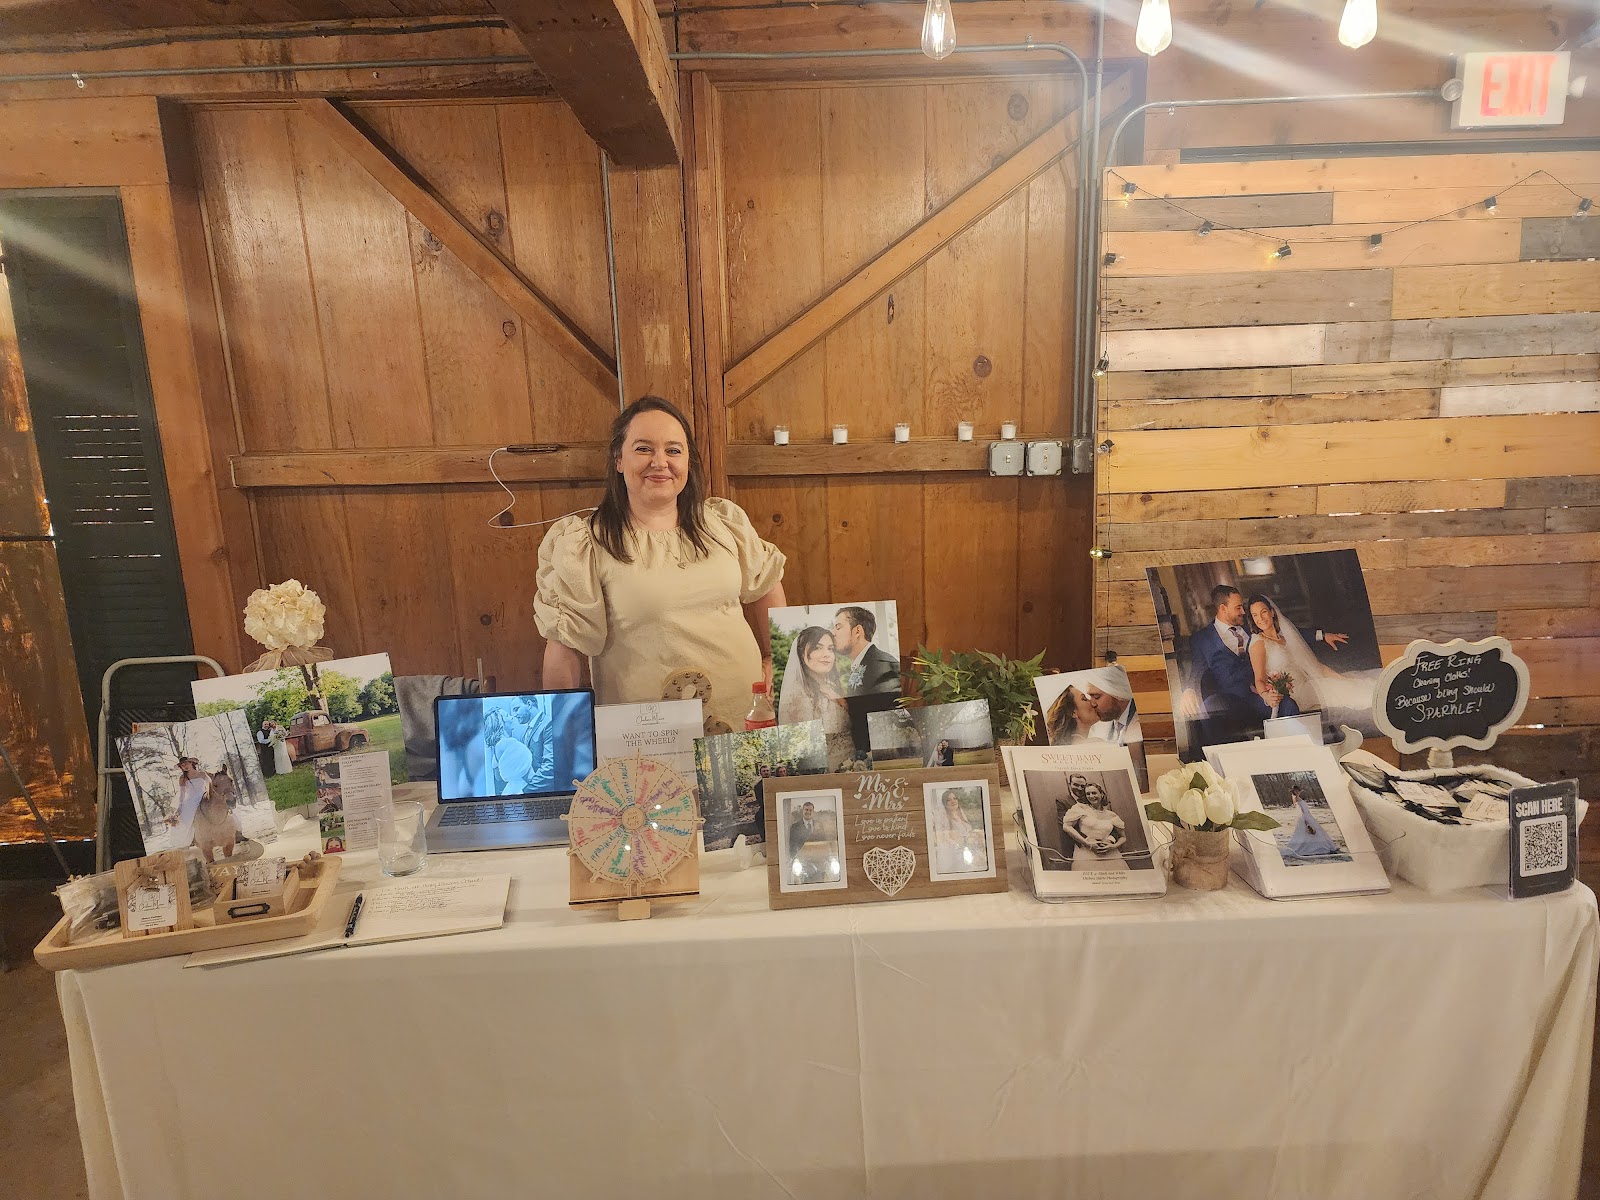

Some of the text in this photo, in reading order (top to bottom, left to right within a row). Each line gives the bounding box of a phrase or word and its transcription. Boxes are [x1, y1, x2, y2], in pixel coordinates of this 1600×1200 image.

[1480, 55, 1558, 117] EXIT
[1411, 655, 1482, 676] FREE RING
[1412, 676, 1441, 689] Cleaning
[1395, 693, 1432, 710] Because
[1411, 698, 1482, 722] SPARKLE!
[622, 732, 646, 740] WANT
[644, 737, 676, 746] WHEEL?
[853, 773, 888, 792] Mr
[864, 791, 904, 810] Mrs
[1516, 800, 1539, 818] SCAN
[1541, 797, 1563, 814] HERE
[855, 815, 874, 826] Love
[883, 812, 912, 827] patient
[862, 824, 882, 834] Love
[891, 822, 907, 831] kind
[855, 831, 875, 842] Love
[898, 828, 916, 840] fails
